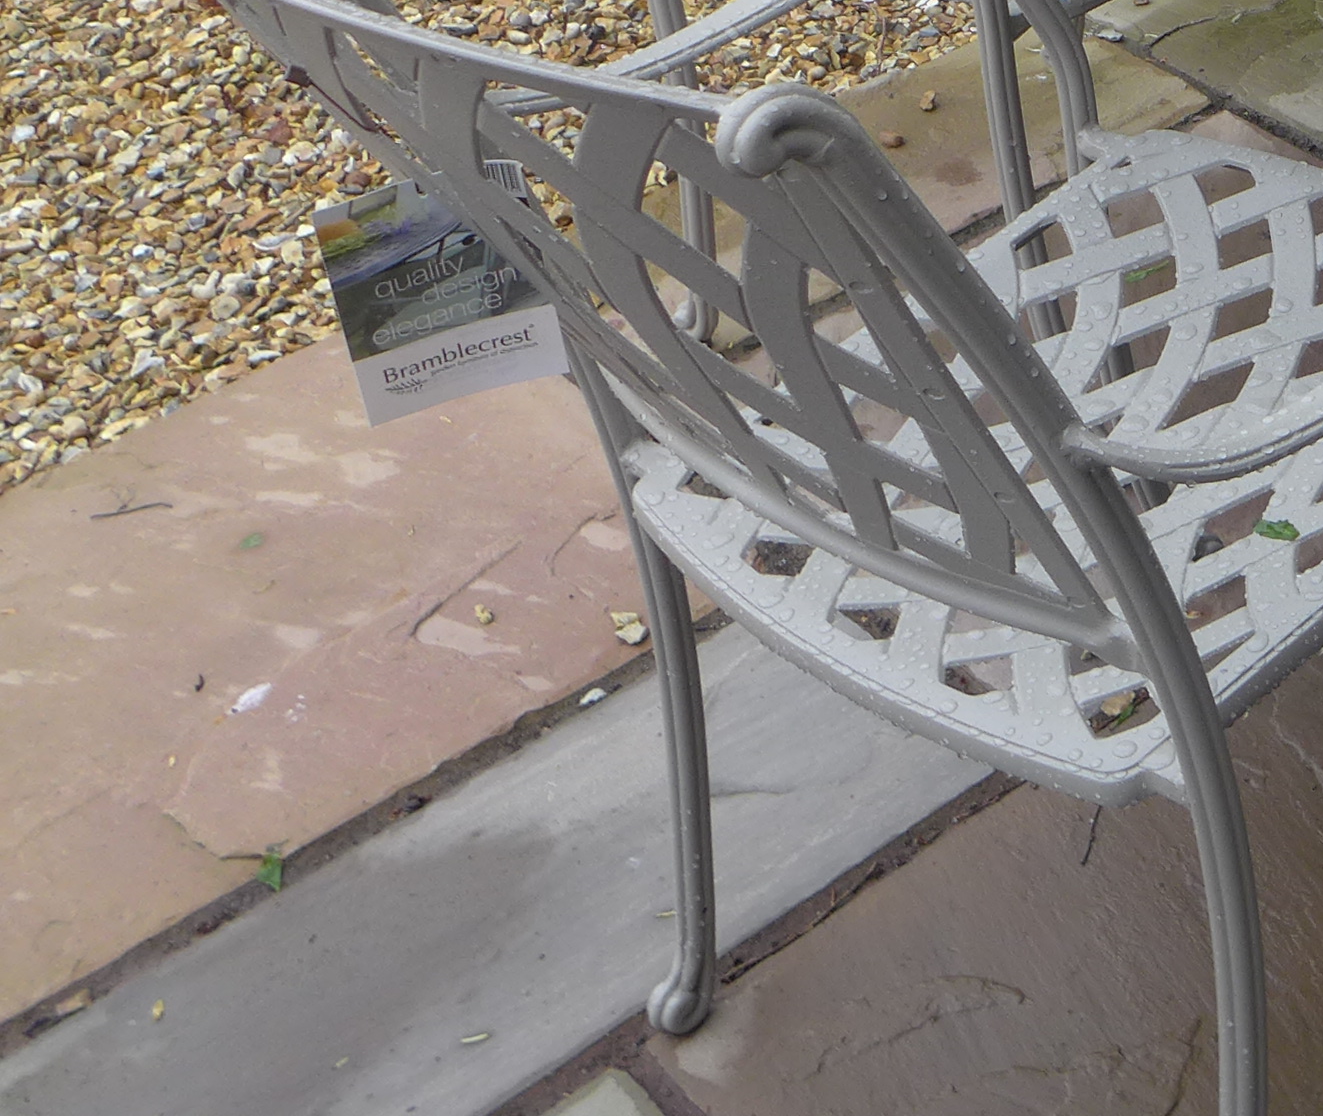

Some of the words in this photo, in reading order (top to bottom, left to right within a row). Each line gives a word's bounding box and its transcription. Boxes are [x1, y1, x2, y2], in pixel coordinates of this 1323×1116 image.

[375, 256, 464, 299] quality
[422, 265, 518, 306] design
[372, 290, 503, 346] elegance
[383, 329, 532, 384] Bramblecrest
